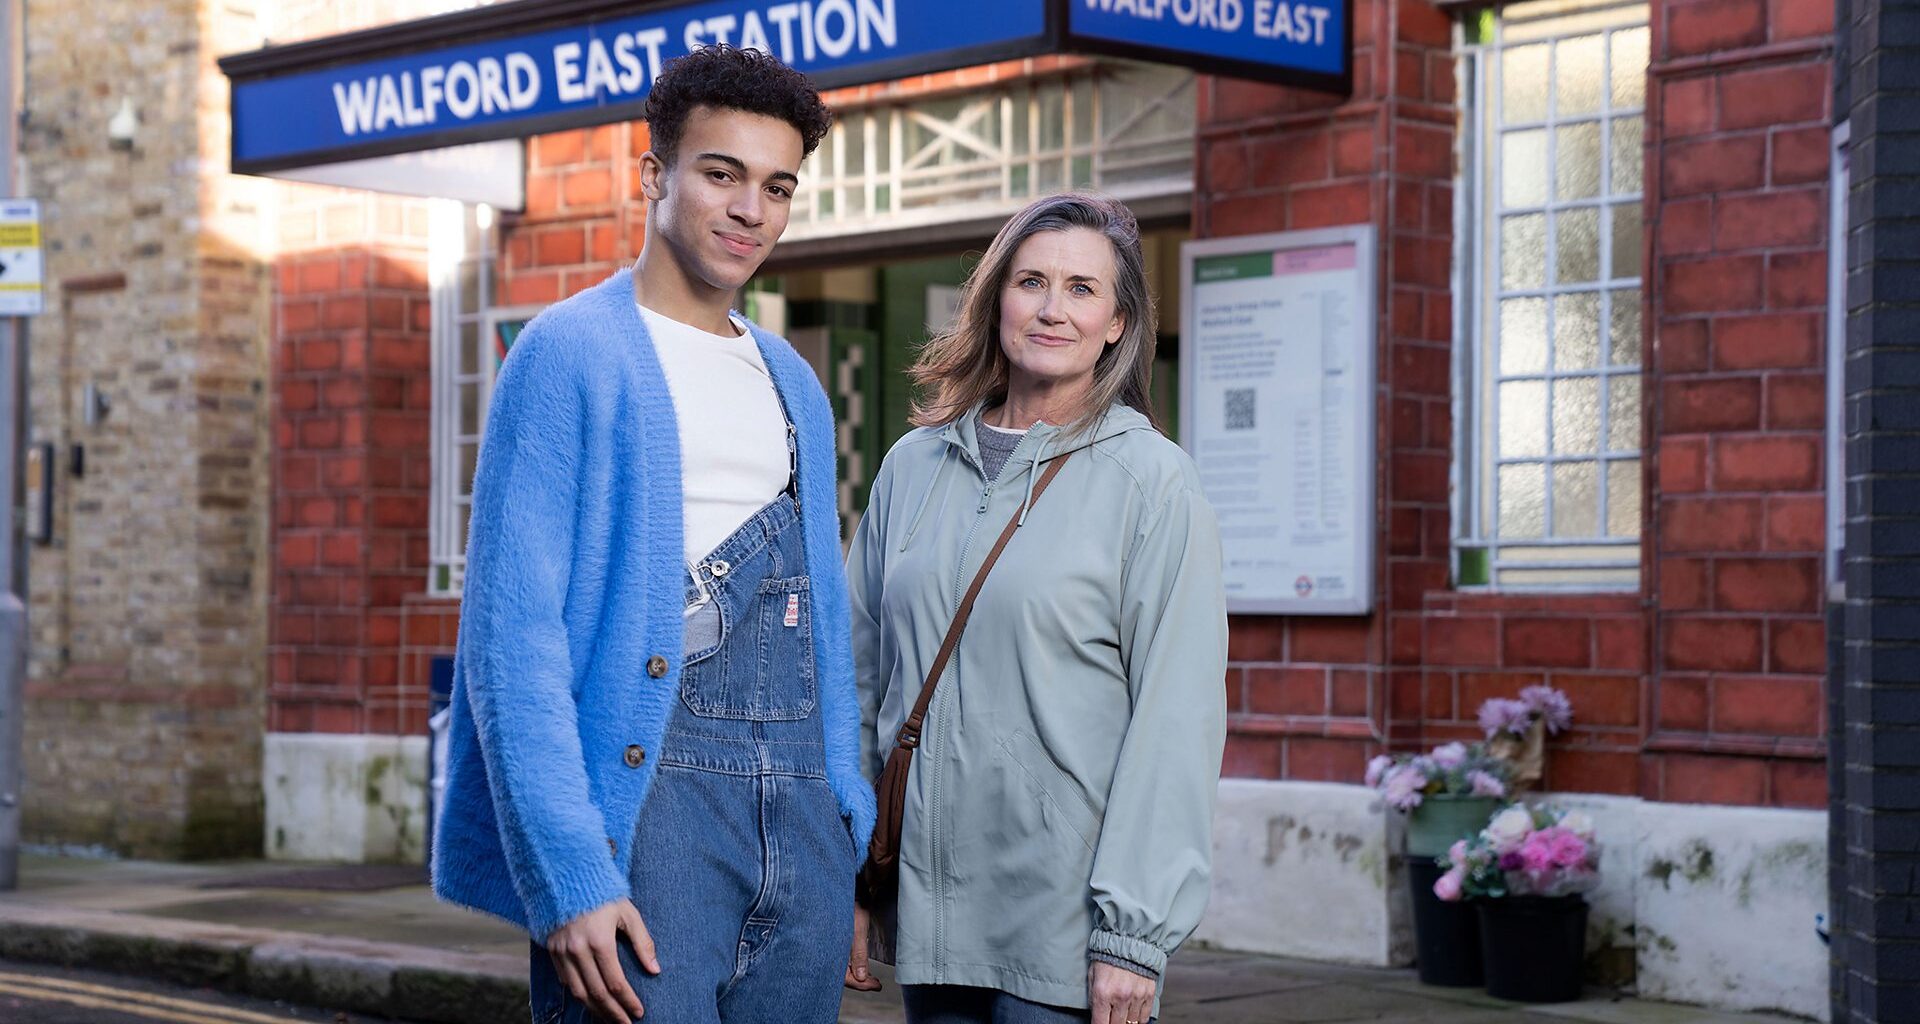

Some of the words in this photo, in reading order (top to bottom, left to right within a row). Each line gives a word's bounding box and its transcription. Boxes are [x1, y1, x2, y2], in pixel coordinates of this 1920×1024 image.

[1084, 0, 1244, 32] FORD
[1253, 0, 1330, 45] EAST
[332, 52, 541, 135] WALFORD
[553, 28, 667, 102] EAST
